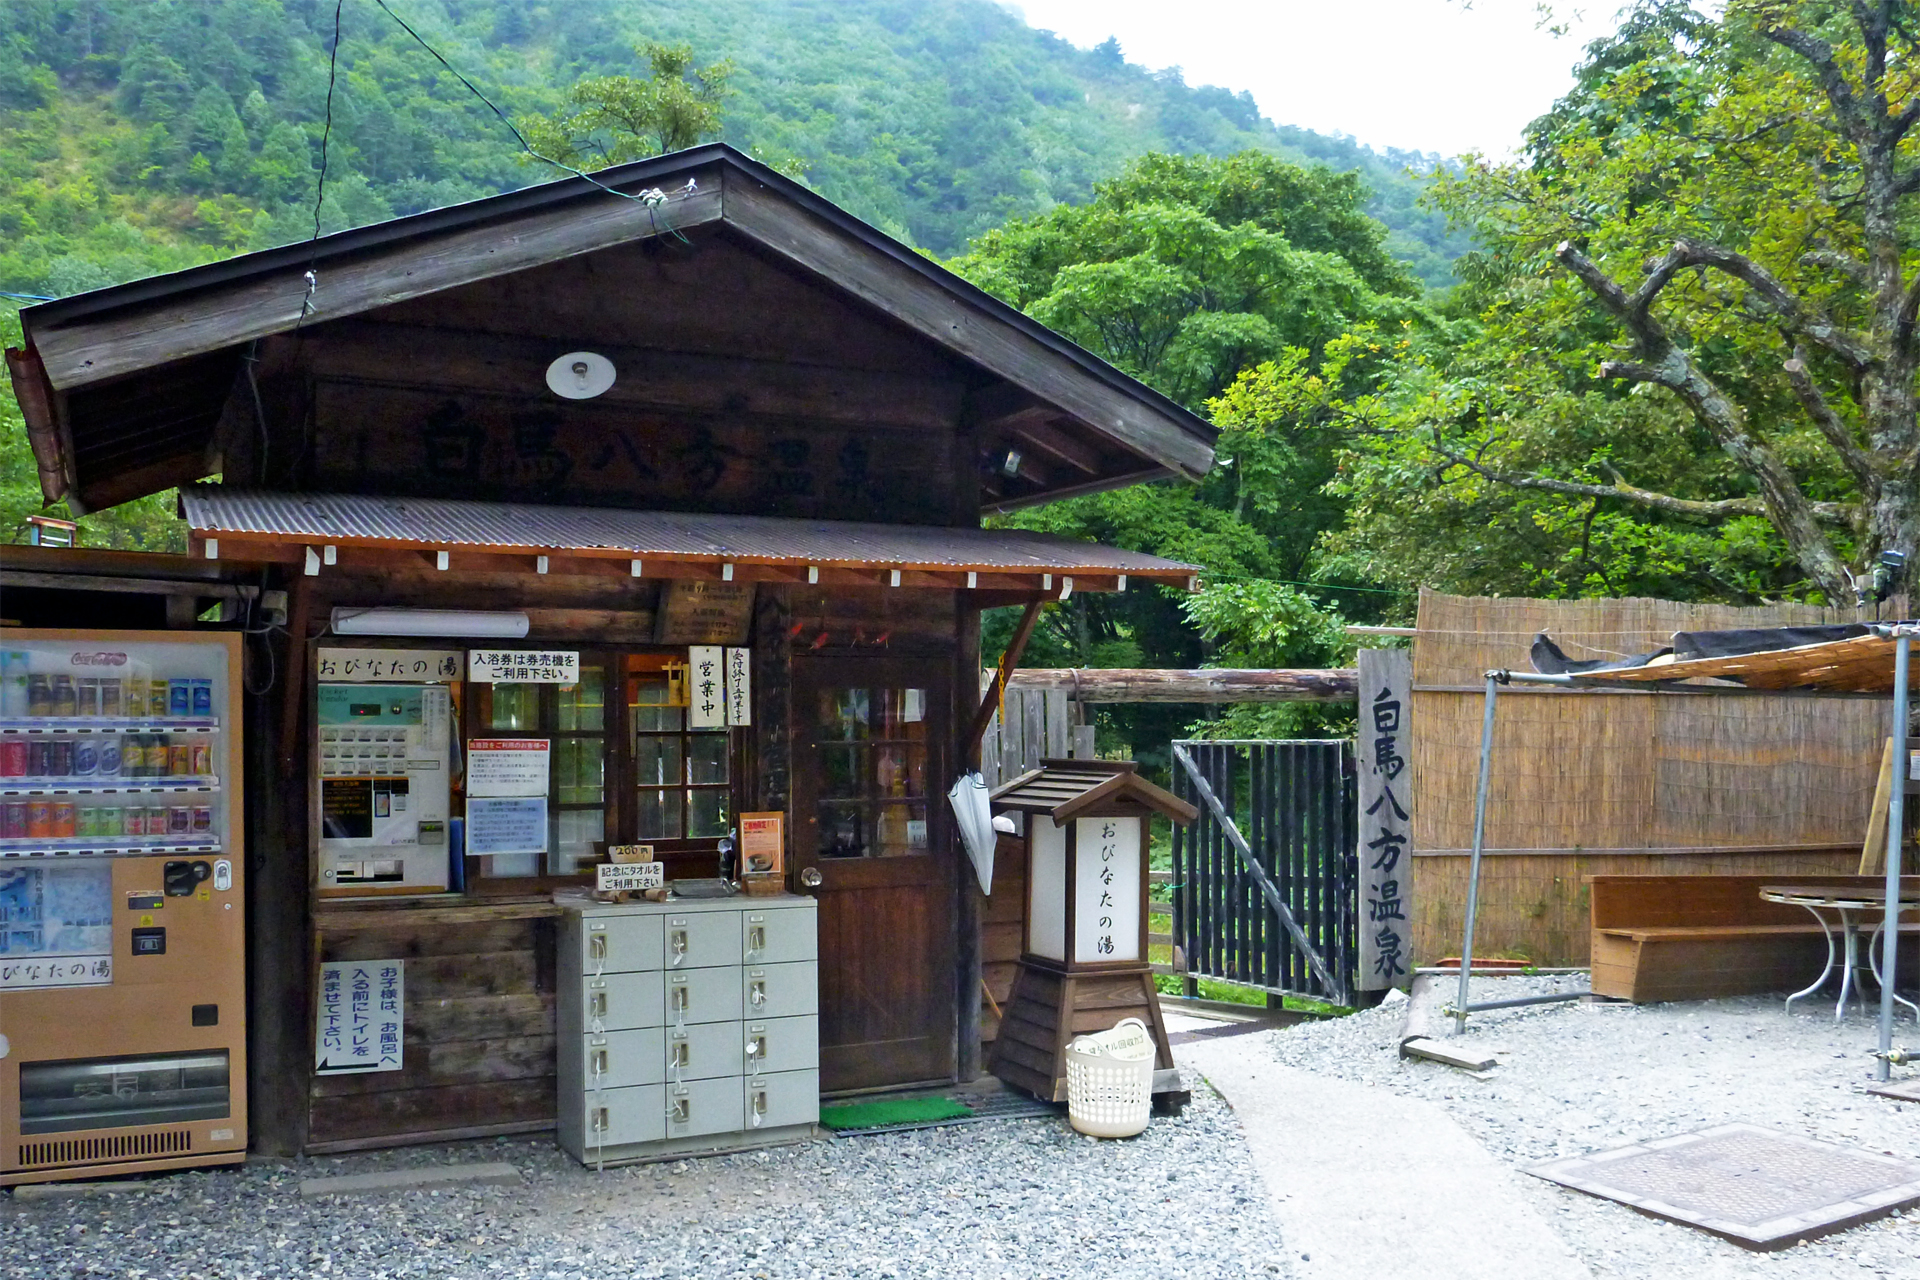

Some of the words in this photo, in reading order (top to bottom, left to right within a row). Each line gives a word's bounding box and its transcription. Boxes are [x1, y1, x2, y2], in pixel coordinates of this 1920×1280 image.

[320, 656, 458, 677] おびなたの湯
[474, 653, 575, 667] 入浴券は券売機を
[491, 666, 569, 680] ご利用下さい。
[698, 660, 716, 718] 営業中
[1366, 687, 1409, 978] 白馬八方温泉
[601, 865, 661, 878] 記念にタオルを
[605, 878, 659, 890] ご利用下さい
[1097, 822, 1116, 955] おびなたの湯
[323, 969, 342, 1052] 済ませて下さい。
[351, 968, 370, 1057] 入る前にトイレを
[379, 966, 398, 1064] お子様は、お風呂へ
